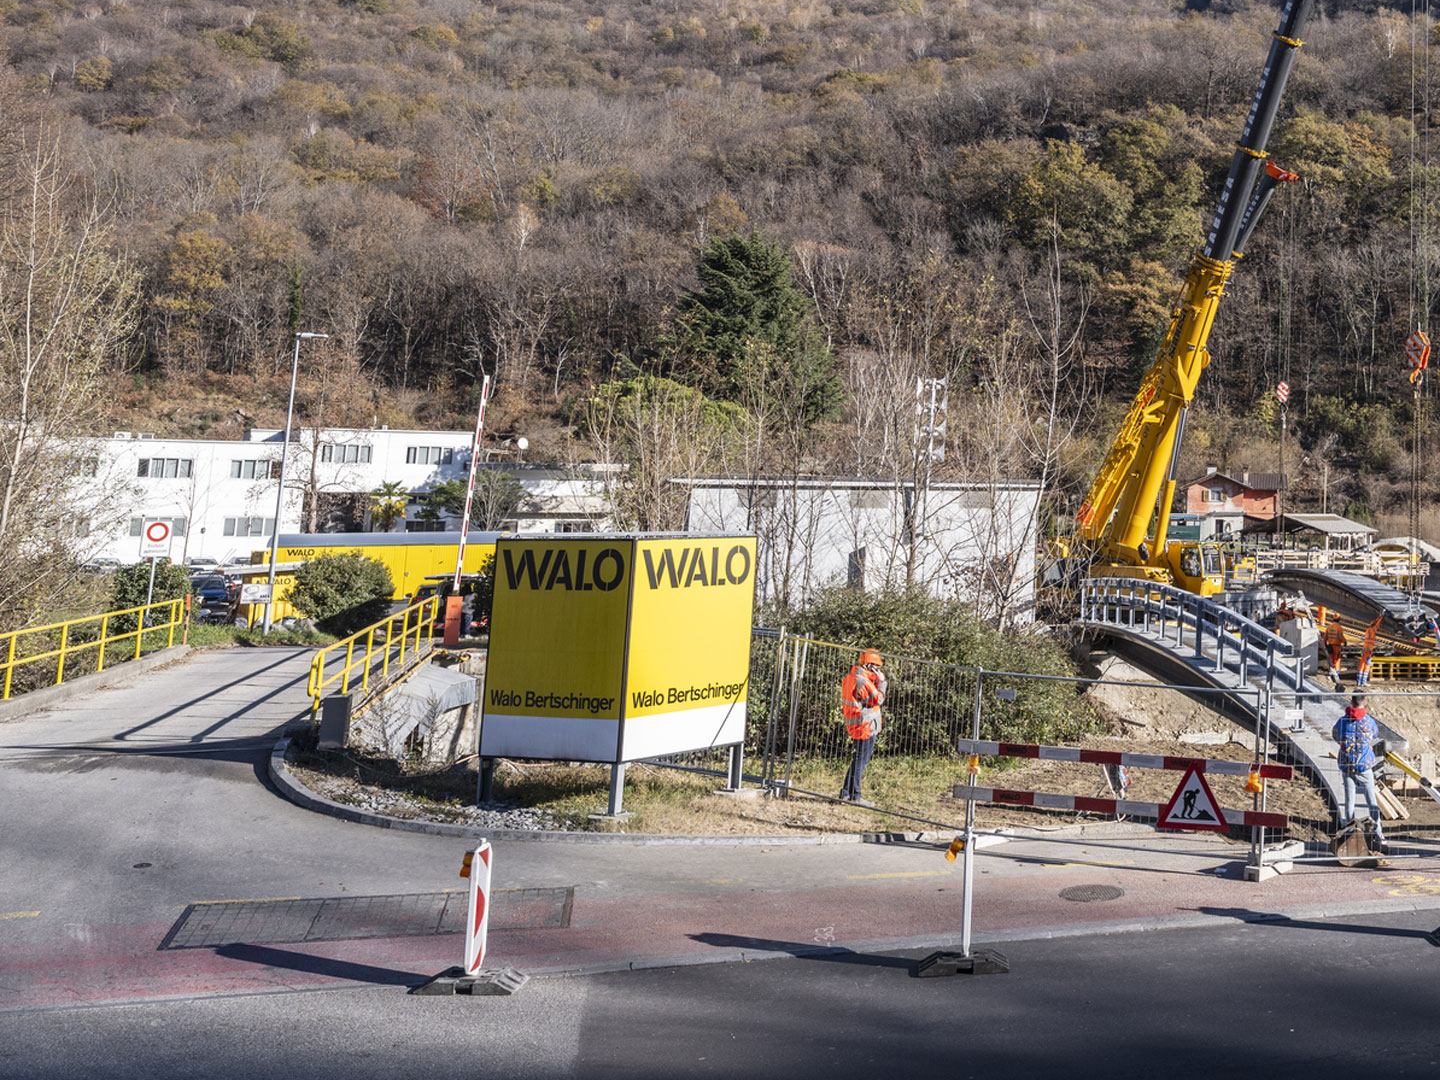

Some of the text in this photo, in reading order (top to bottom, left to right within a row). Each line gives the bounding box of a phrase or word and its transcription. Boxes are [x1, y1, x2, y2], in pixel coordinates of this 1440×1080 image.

[1203, 177, 1235, 257] SABESA
[287, 548, 315, 557] WALO
[502, 548, 625, 592] WALO
[642, 545, 751, 590] WALO
[490, 689, 616, 714] Walo Bertschinger
[632, 681, 745, 709] Walo Bertschinger
